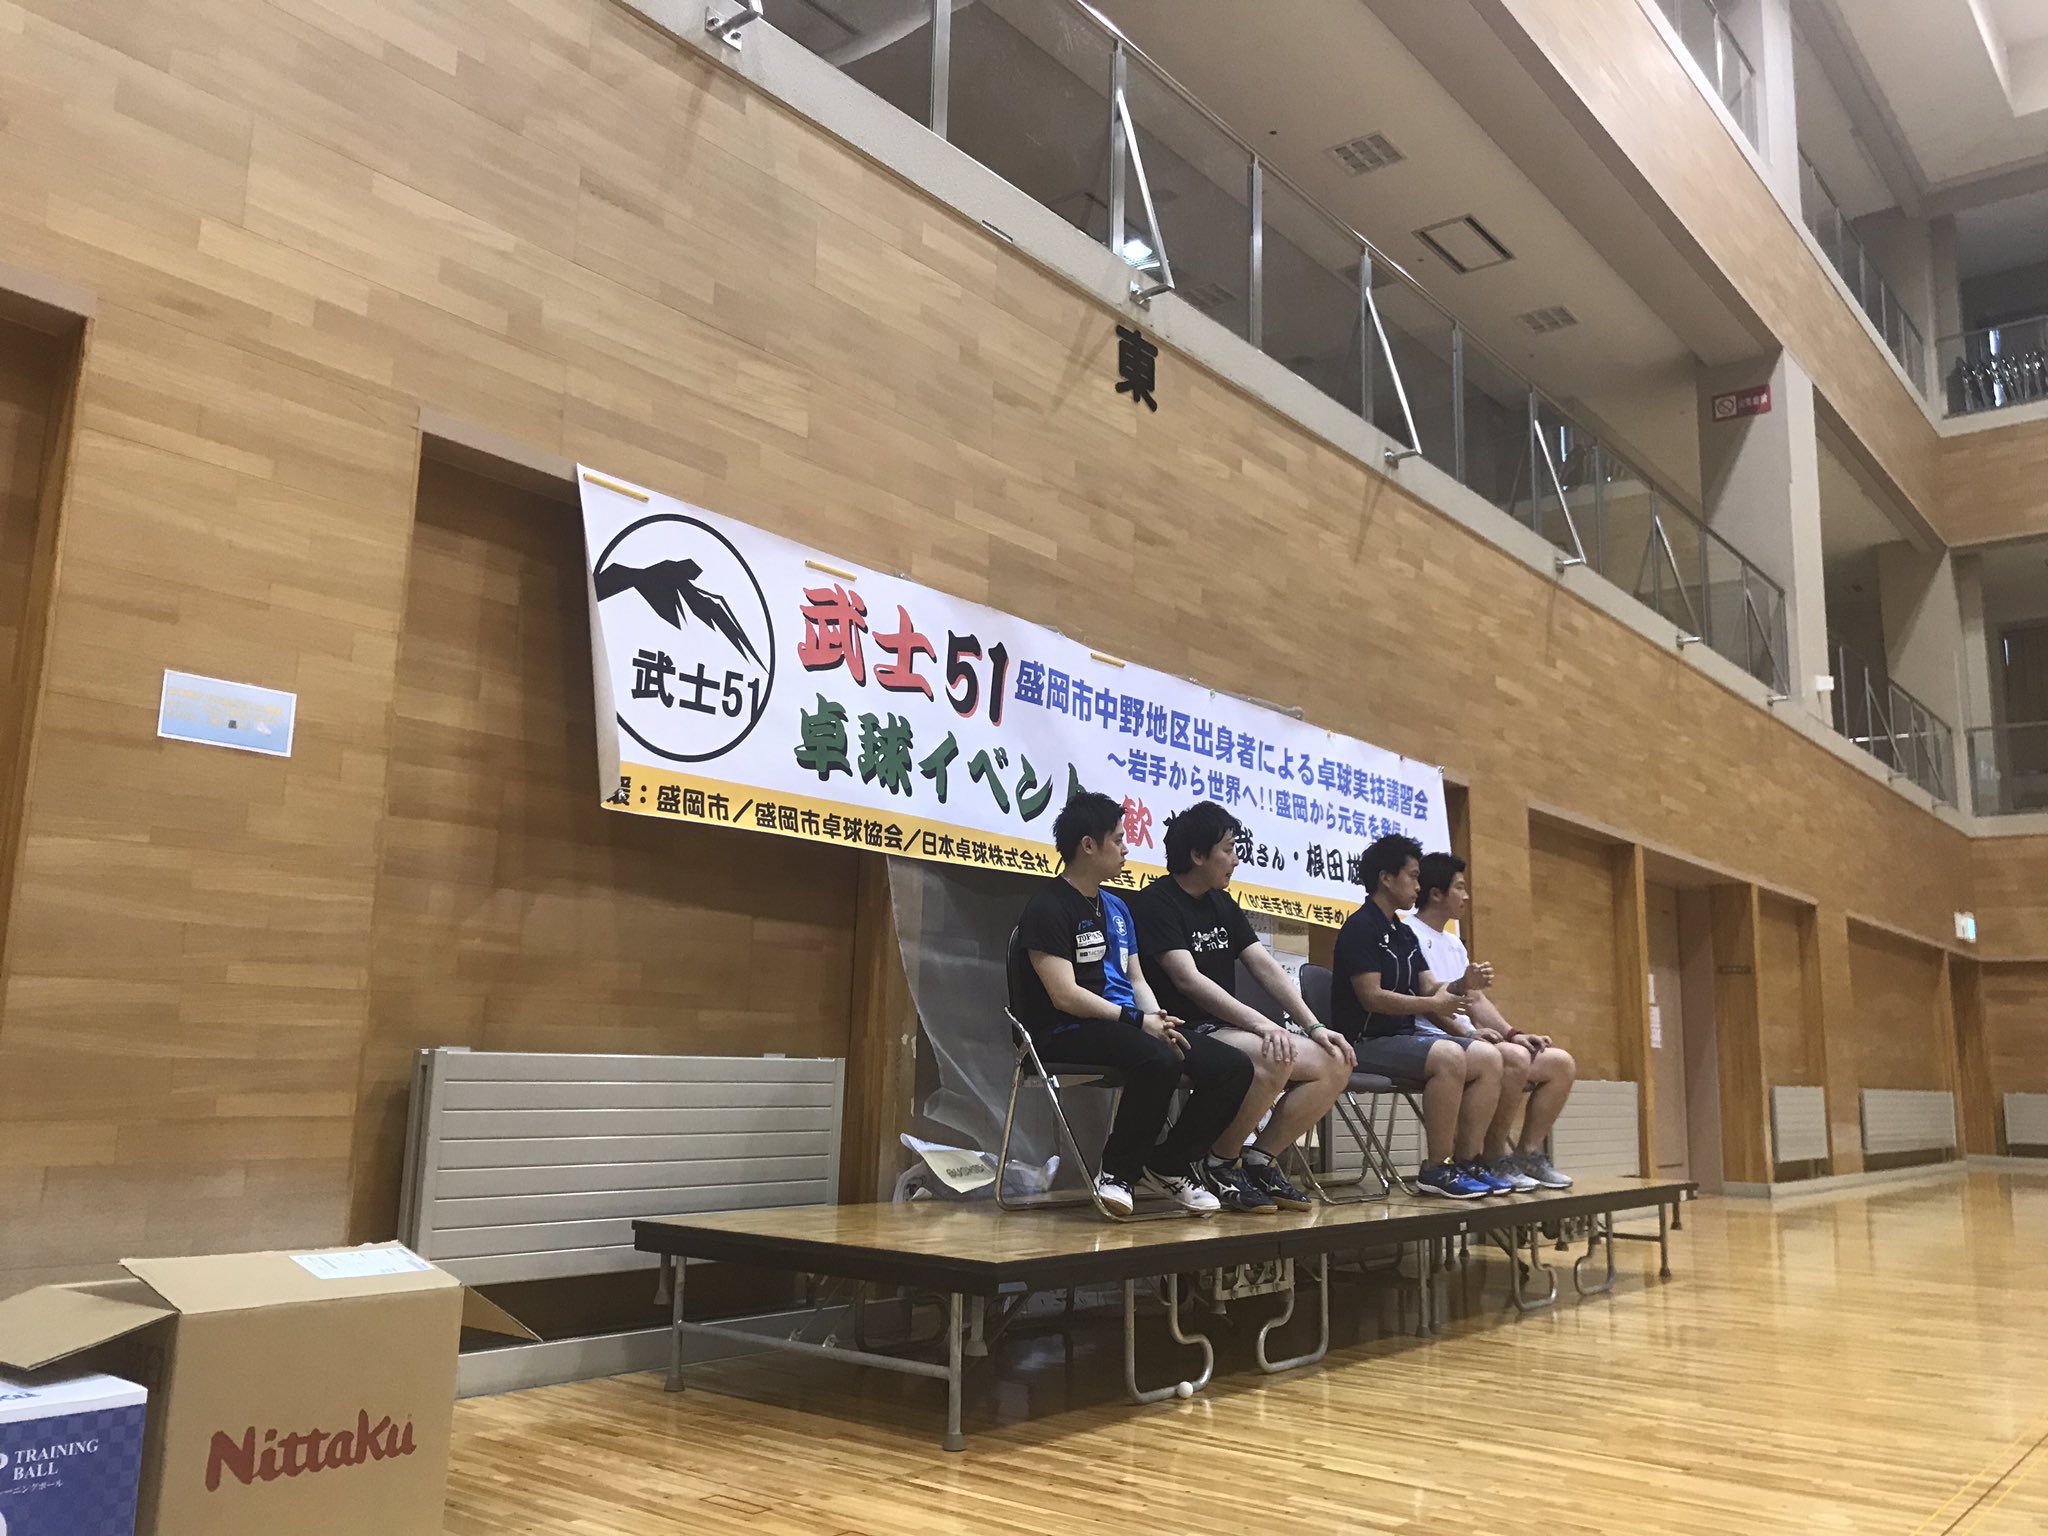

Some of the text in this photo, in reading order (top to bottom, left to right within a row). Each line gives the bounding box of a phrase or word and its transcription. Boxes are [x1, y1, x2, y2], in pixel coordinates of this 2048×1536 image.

[1115, 325, 1158, 413] 東
[631, 648, 760, 724] 武士51
[797, 583, 1009, 727] 武士51
[1015, 659, 1429, 821] 盛岡市中野地区出身者による卓球実技講習会
[0, 1479, 64, 1496] ーニングボール
[13, 1461, 59, 1481] BALL
[14, 1438, 99, 1465] TRAINING
